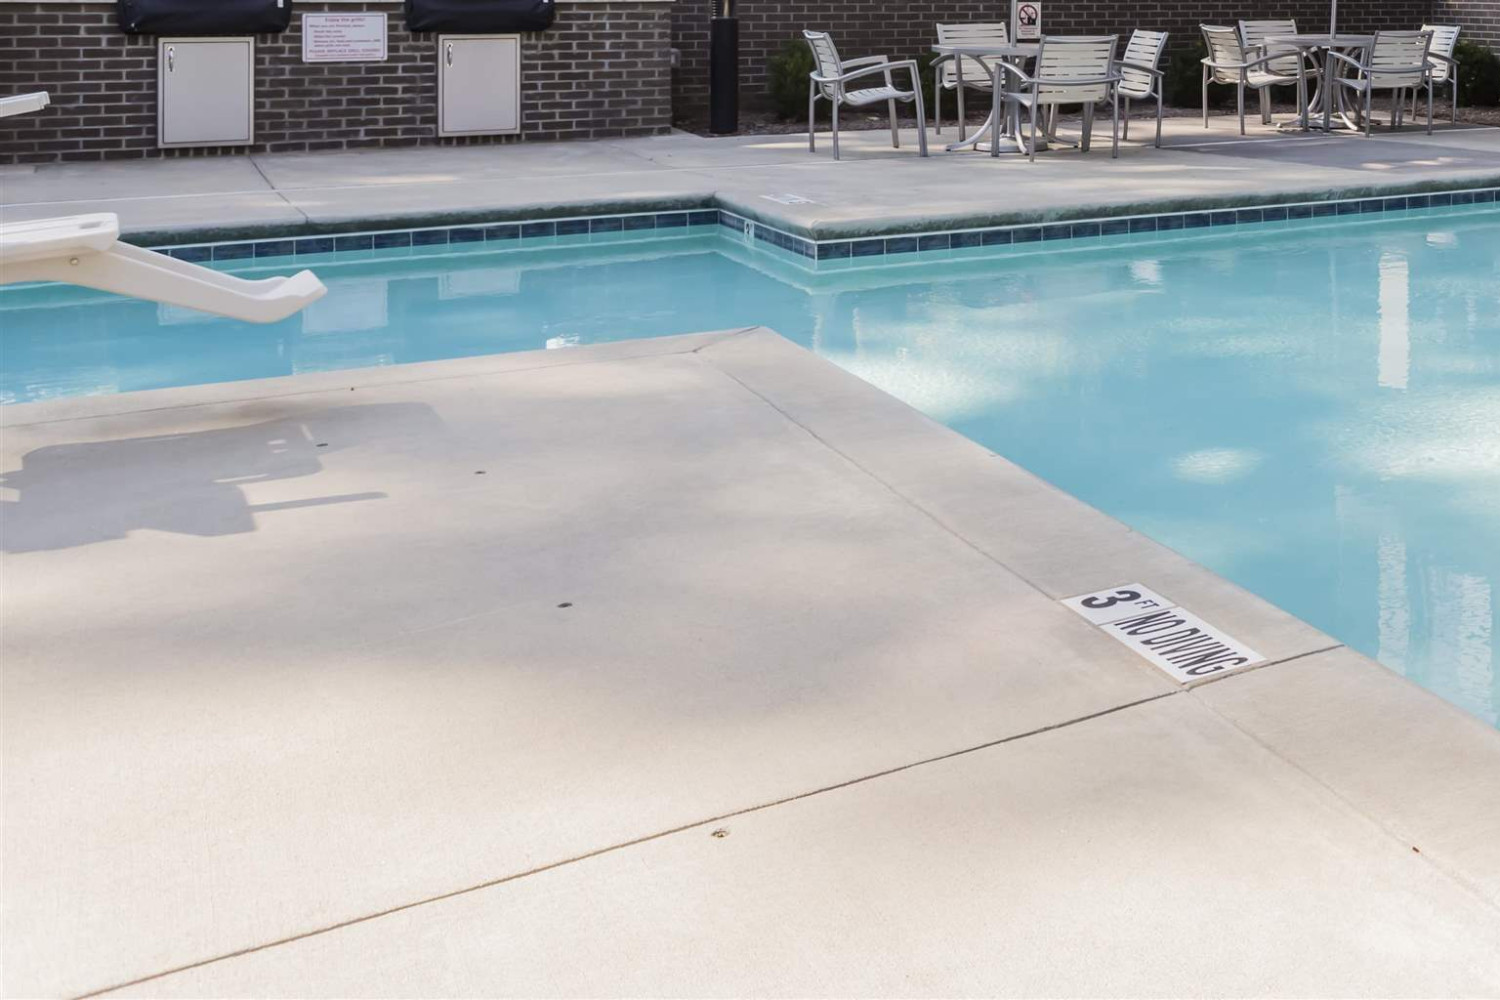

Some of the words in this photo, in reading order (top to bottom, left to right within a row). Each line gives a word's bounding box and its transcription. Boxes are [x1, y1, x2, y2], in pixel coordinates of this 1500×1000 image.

[1081, 590, 1142, 609] 3
[1134, 599, 1160, 609] FT
[1113, 611, 1186, 636] NO
[1140, 627, 1249, 676] DIVING
